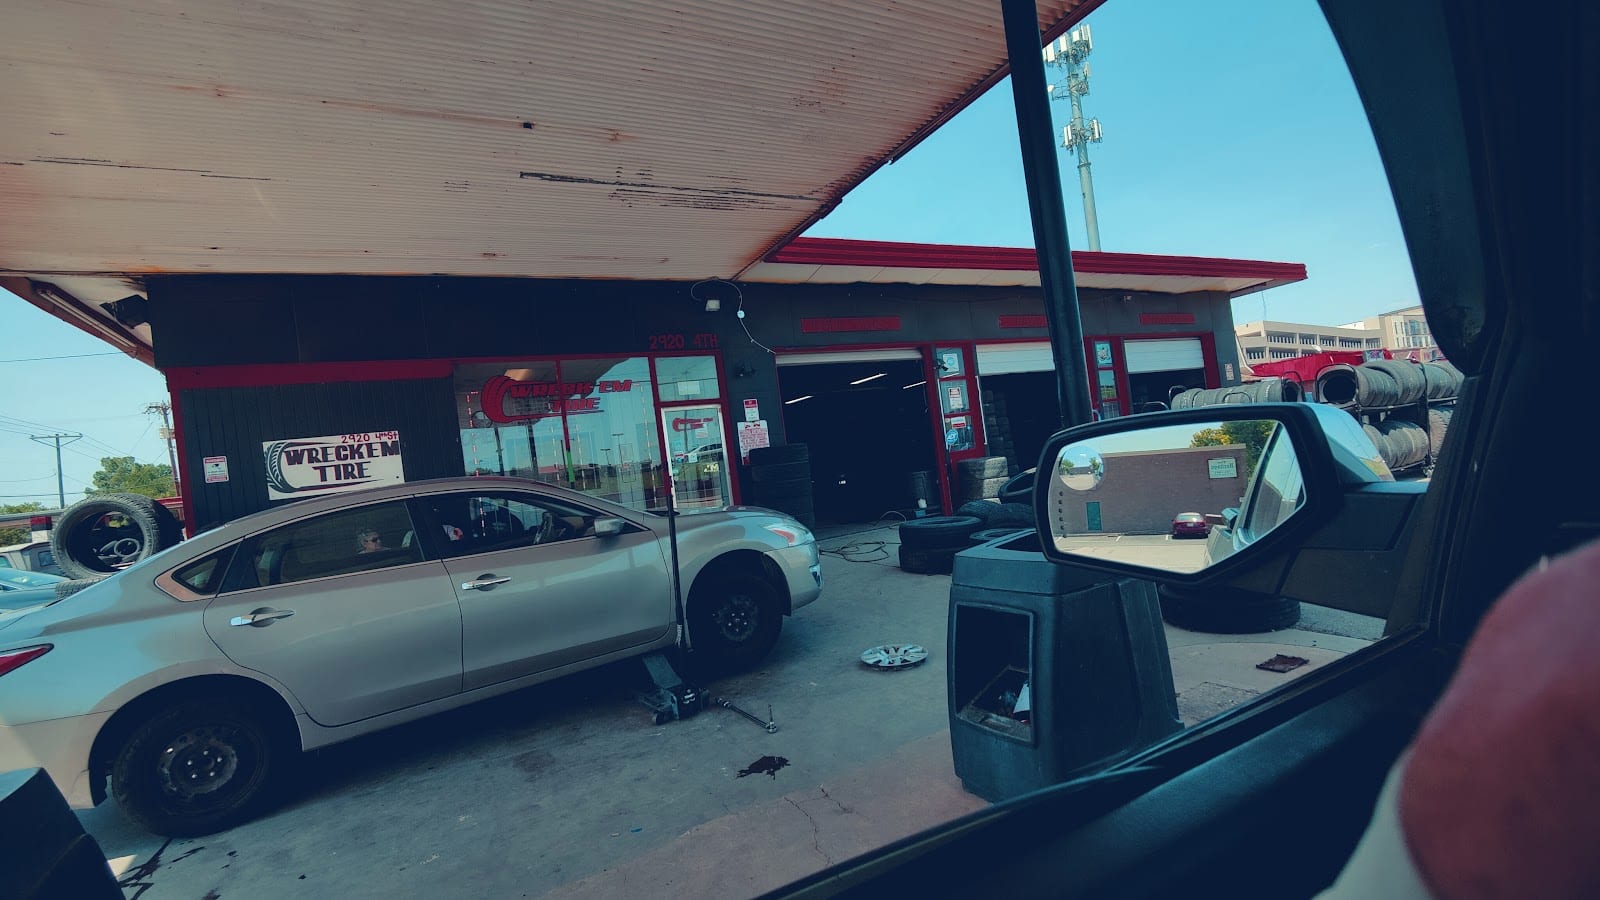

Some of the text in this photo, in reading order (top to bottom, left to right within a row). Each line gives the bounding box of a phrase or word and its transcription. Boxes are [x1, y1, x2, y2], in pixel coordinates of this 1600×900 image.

[648, 333, 718, 351] 2920 4TH
[341, 433, 370, 444] 2920
[312, 460, 372, 483] TIRE
